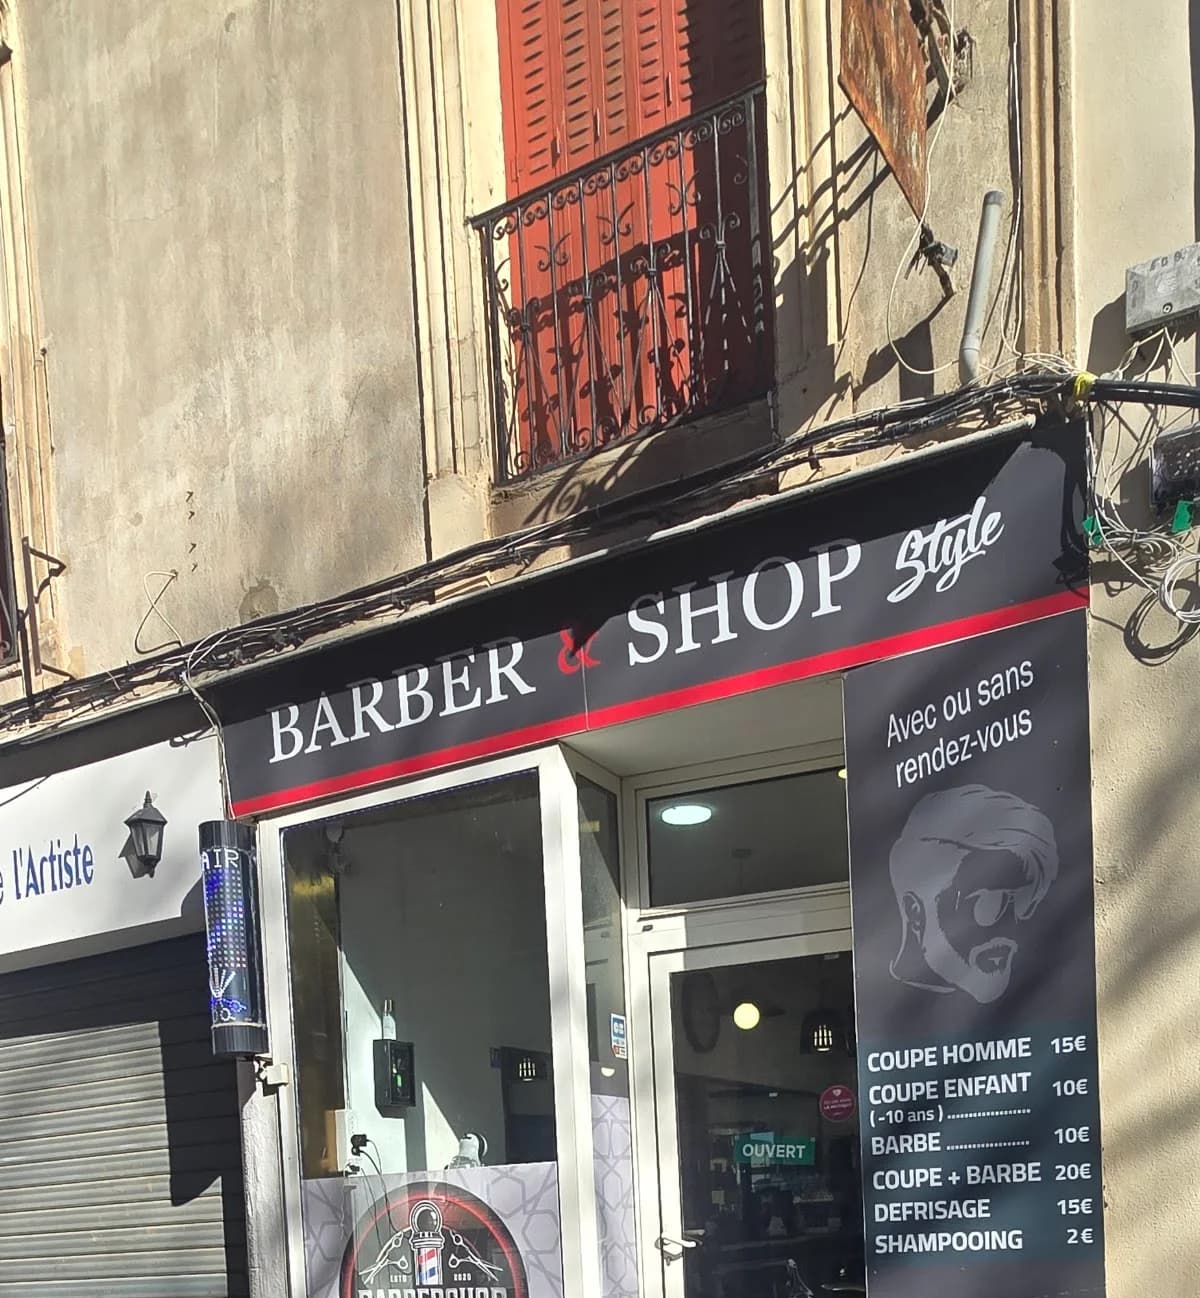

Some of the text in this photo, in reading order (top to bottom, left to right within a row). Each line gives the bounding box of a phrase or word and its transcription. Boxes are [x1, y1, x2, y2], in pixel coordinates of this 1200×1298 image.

[269, 496, 1005, 763] BARBER & SHOP Style
[887, 660, 1034, 748] Avec ou sans
[895, 708, 1033, 788] rendez-vous
[12, 832, 94, 900] l'Artiste
[867, 1035, 1087, 1073] COUPE HOMME 15€
[869, 1080, 939, 1105] COUPE
[944, 1071, 1032, 1098] ENFANT
[1052, 1078, 1089, 1097] 10€
[742, 1143, 806, 1159] OUVERT
[871, 1126, 1090, 1156] BARBE 10€
[872, 1162, 1092, 1190] COUPE + BARBE 20€
[874, 1198, 1093, 1223] DEFRISAGE 15€
[875, 1230, 1023, 1254] SHAMPOOING
